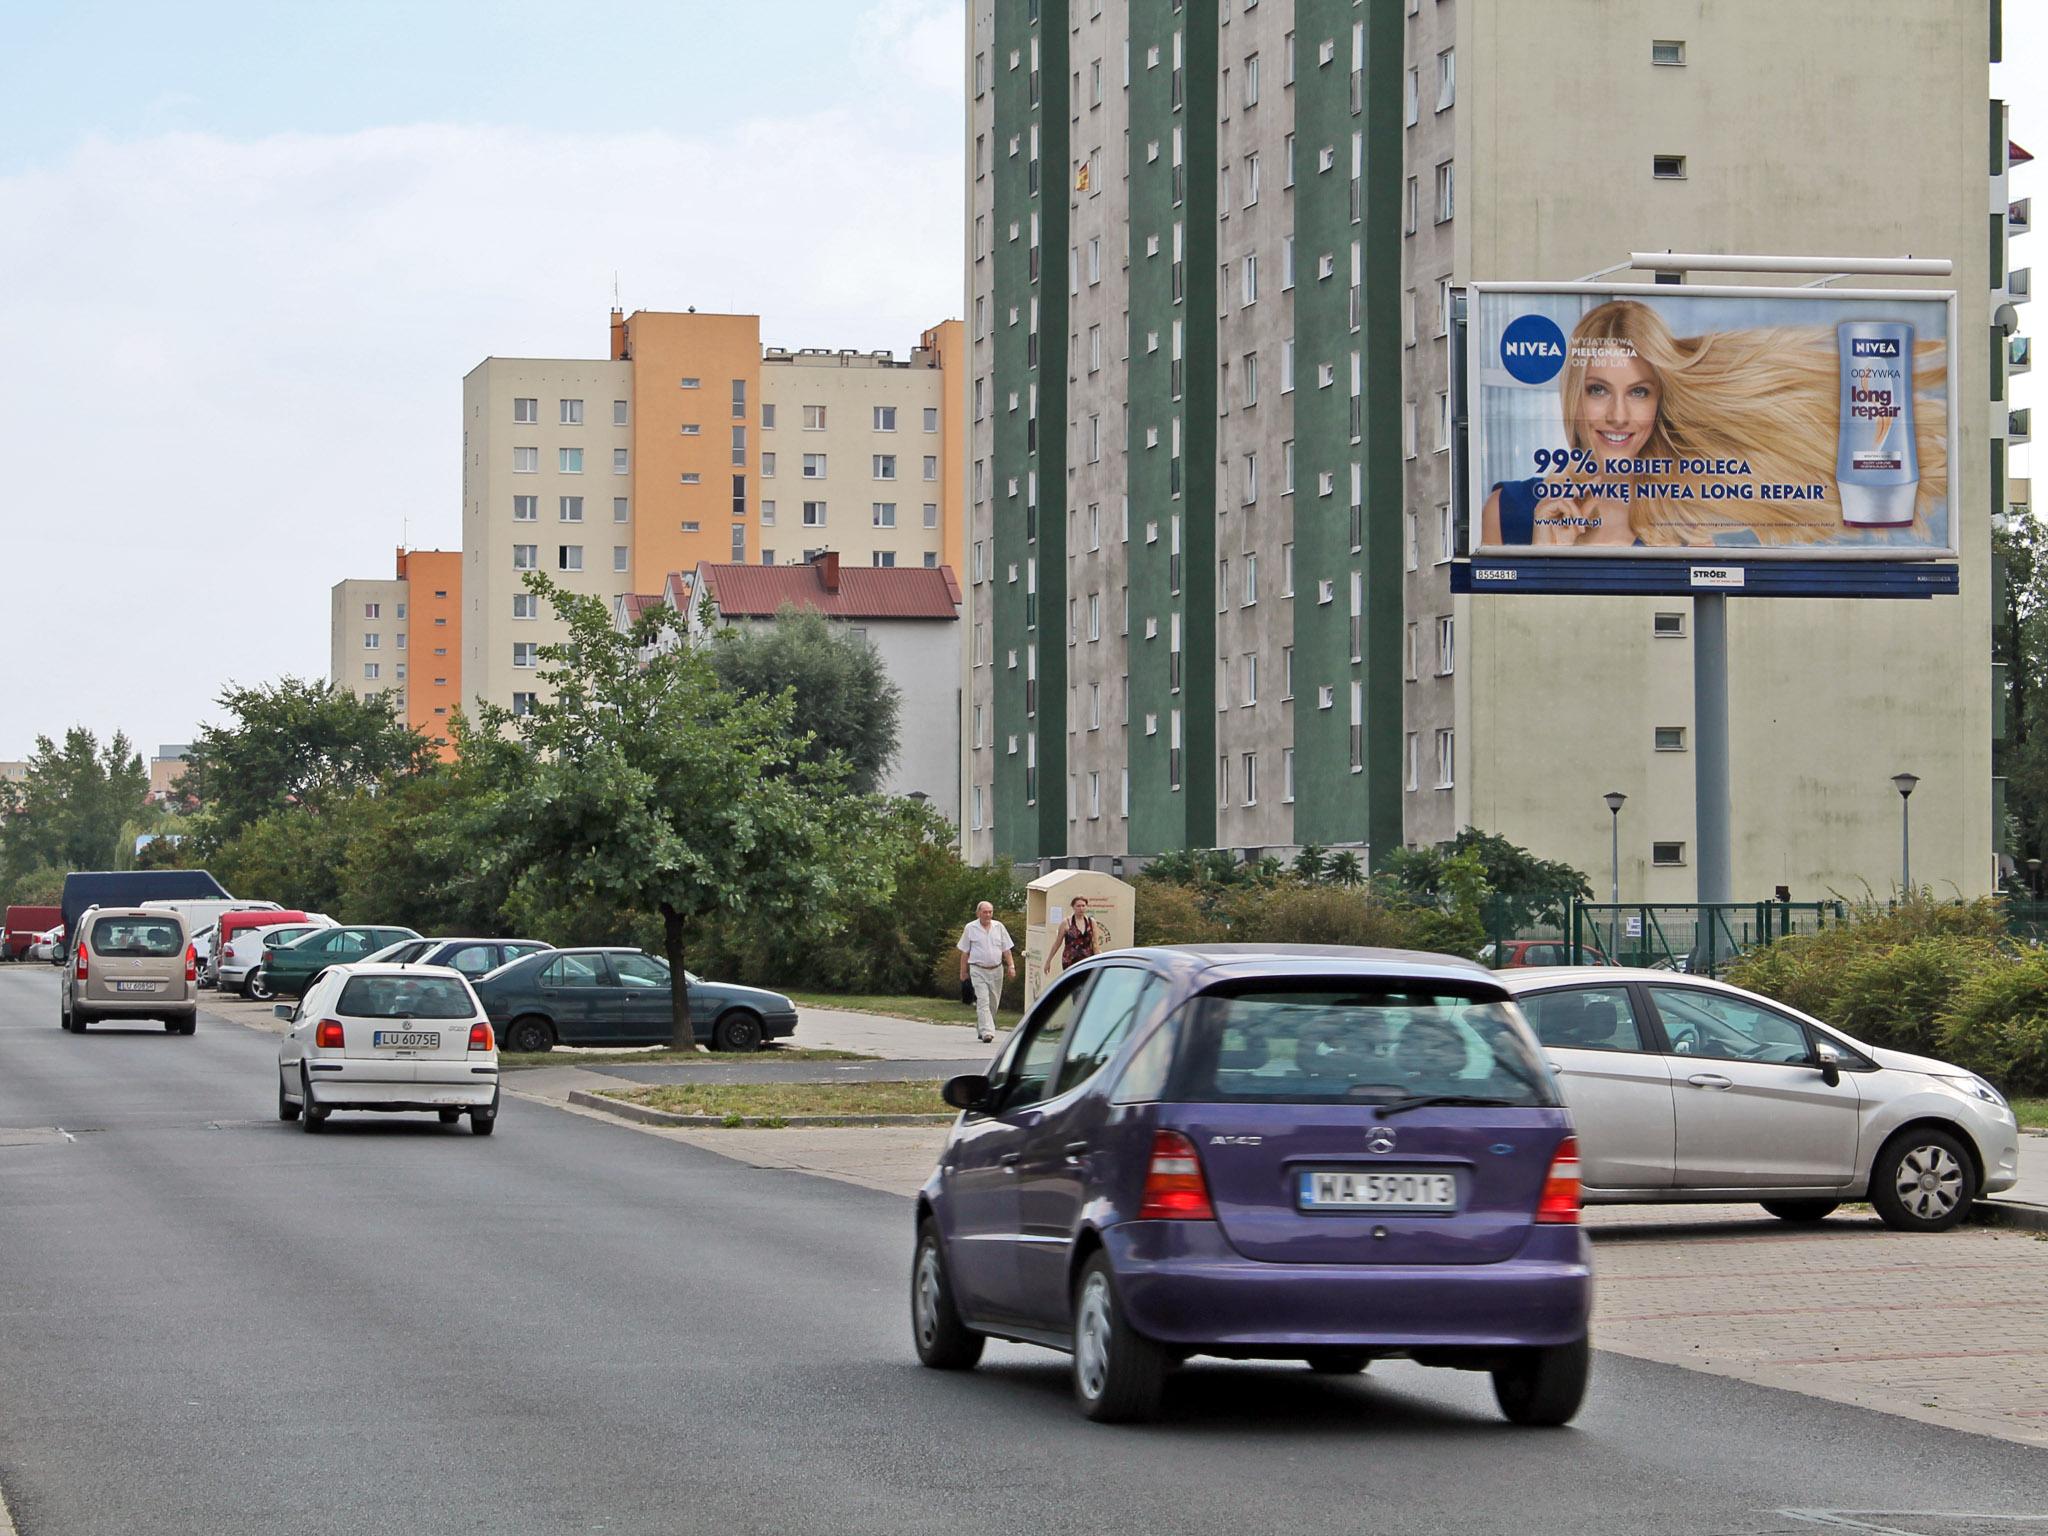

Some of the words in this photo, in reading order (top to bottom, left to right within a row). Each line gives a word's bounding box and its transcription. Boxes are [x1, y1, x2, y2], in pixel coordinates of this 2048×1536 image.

[1506, 341, 1562, 357] NIVEA
[1571, 347, 1638, 359] PIELĘGNACJA
[1856, 342, 1896, 354] NIVEA
[1571, 358, 1588, 368] OD
[1591, 358, 1607, 368] 100
[1850, 368, 1901, 379] ODŻYWKA
[1851, 386, 1892, 406] long
[1851, 405, 1901, 420] repair
[1533, 448, 1598, 474] 99%
[1605, 459, 1673, 474] KOBIET
[1679, 459, 1752, 475] POLECA
[1533, 478, 1630, 503] ODŻYWKĘ
[1637, 484, 1695, 499] NIVEA
[1701, 484, 1753, 499] LONG
[1534, 517, 1602, 528] www.NIVEA.pl
[383, 1033, 399, 1045] LU
[402, 1034, 437, 1046] 6075E
[1368, 1175, 1452, 1203] 59013
